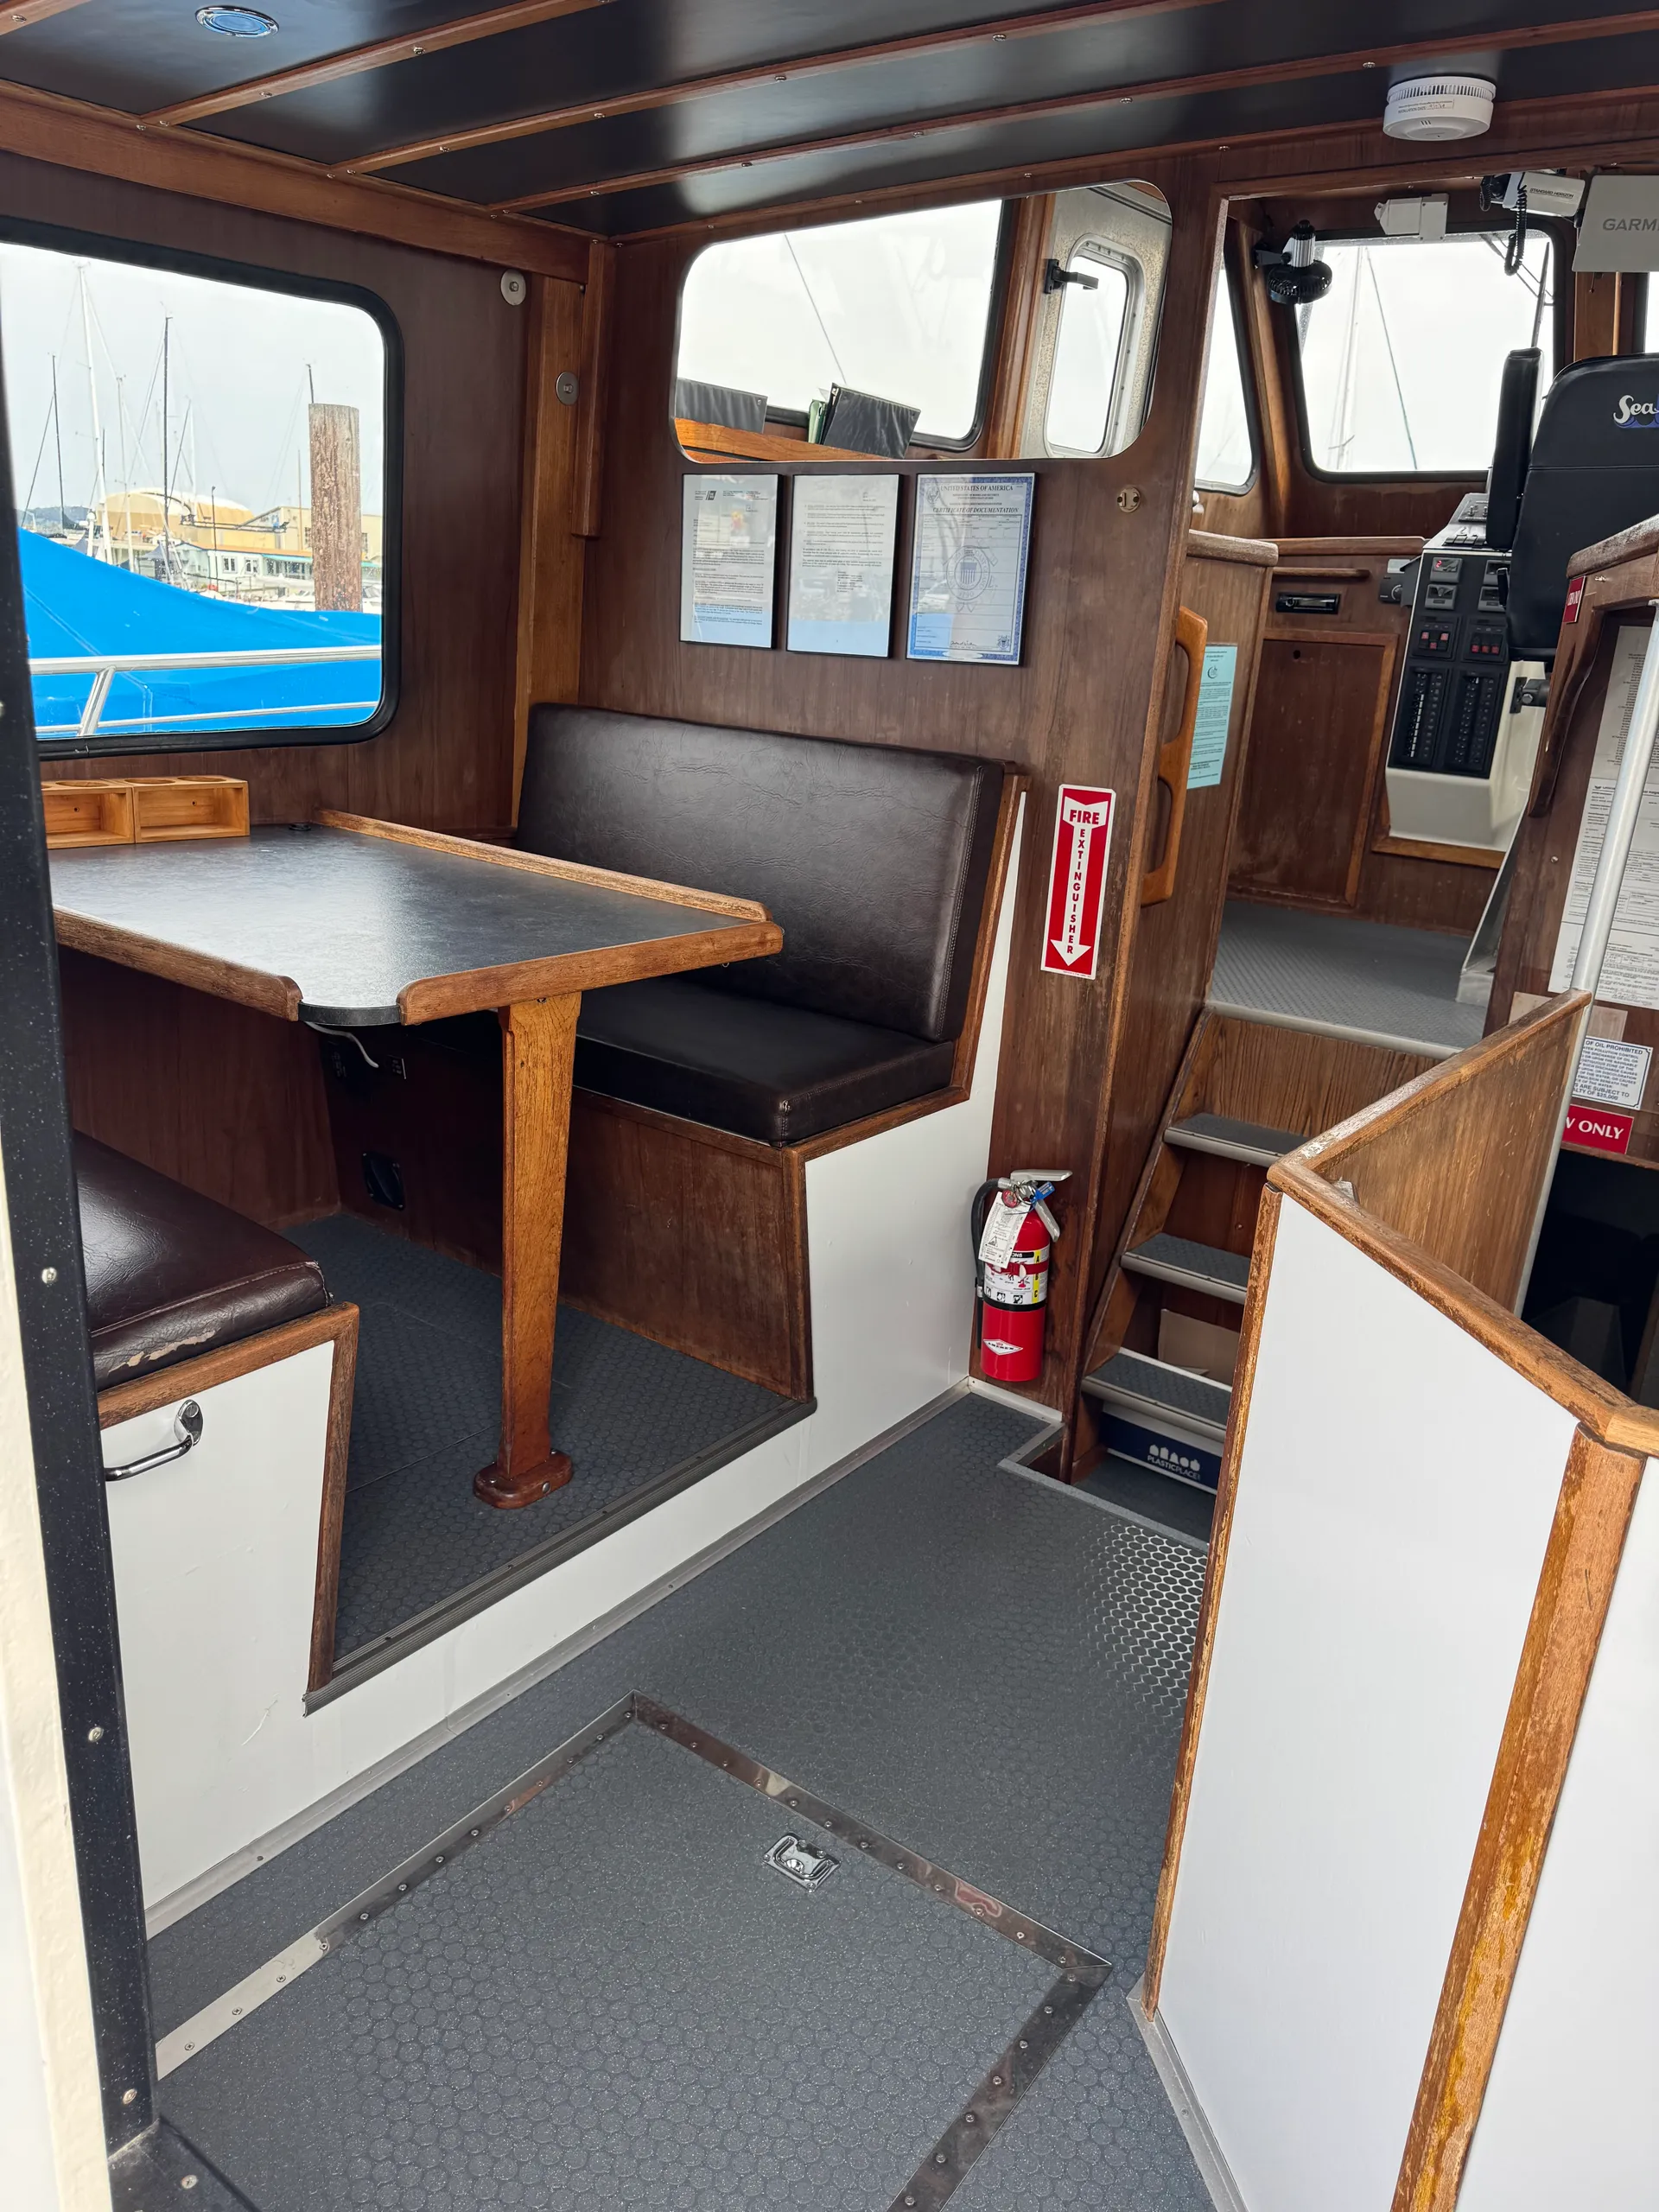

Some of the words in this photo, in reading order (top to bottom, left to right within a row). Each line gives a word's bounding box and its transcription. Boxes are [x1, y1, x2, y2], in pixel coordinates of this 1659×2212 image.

[1602, 218, 1659, 231] GARM
[1069, 809, 1100, 825] FIRE
[1066, 829, 1085, 954] EXTINGUISHER
[1606, 1044, 1643, 1055] PROHIBITED
[1602, 1071, 1637, 1080] DISCOLORATION
[1593, 1087, 1620, 1095] SUBJECT
[1597, 1092, 1618, 1100] $25,000
[1578, 1120, 1624, 1140] ONLY
[1147, 1455, 1198, 1479] PLASTICPLACE
